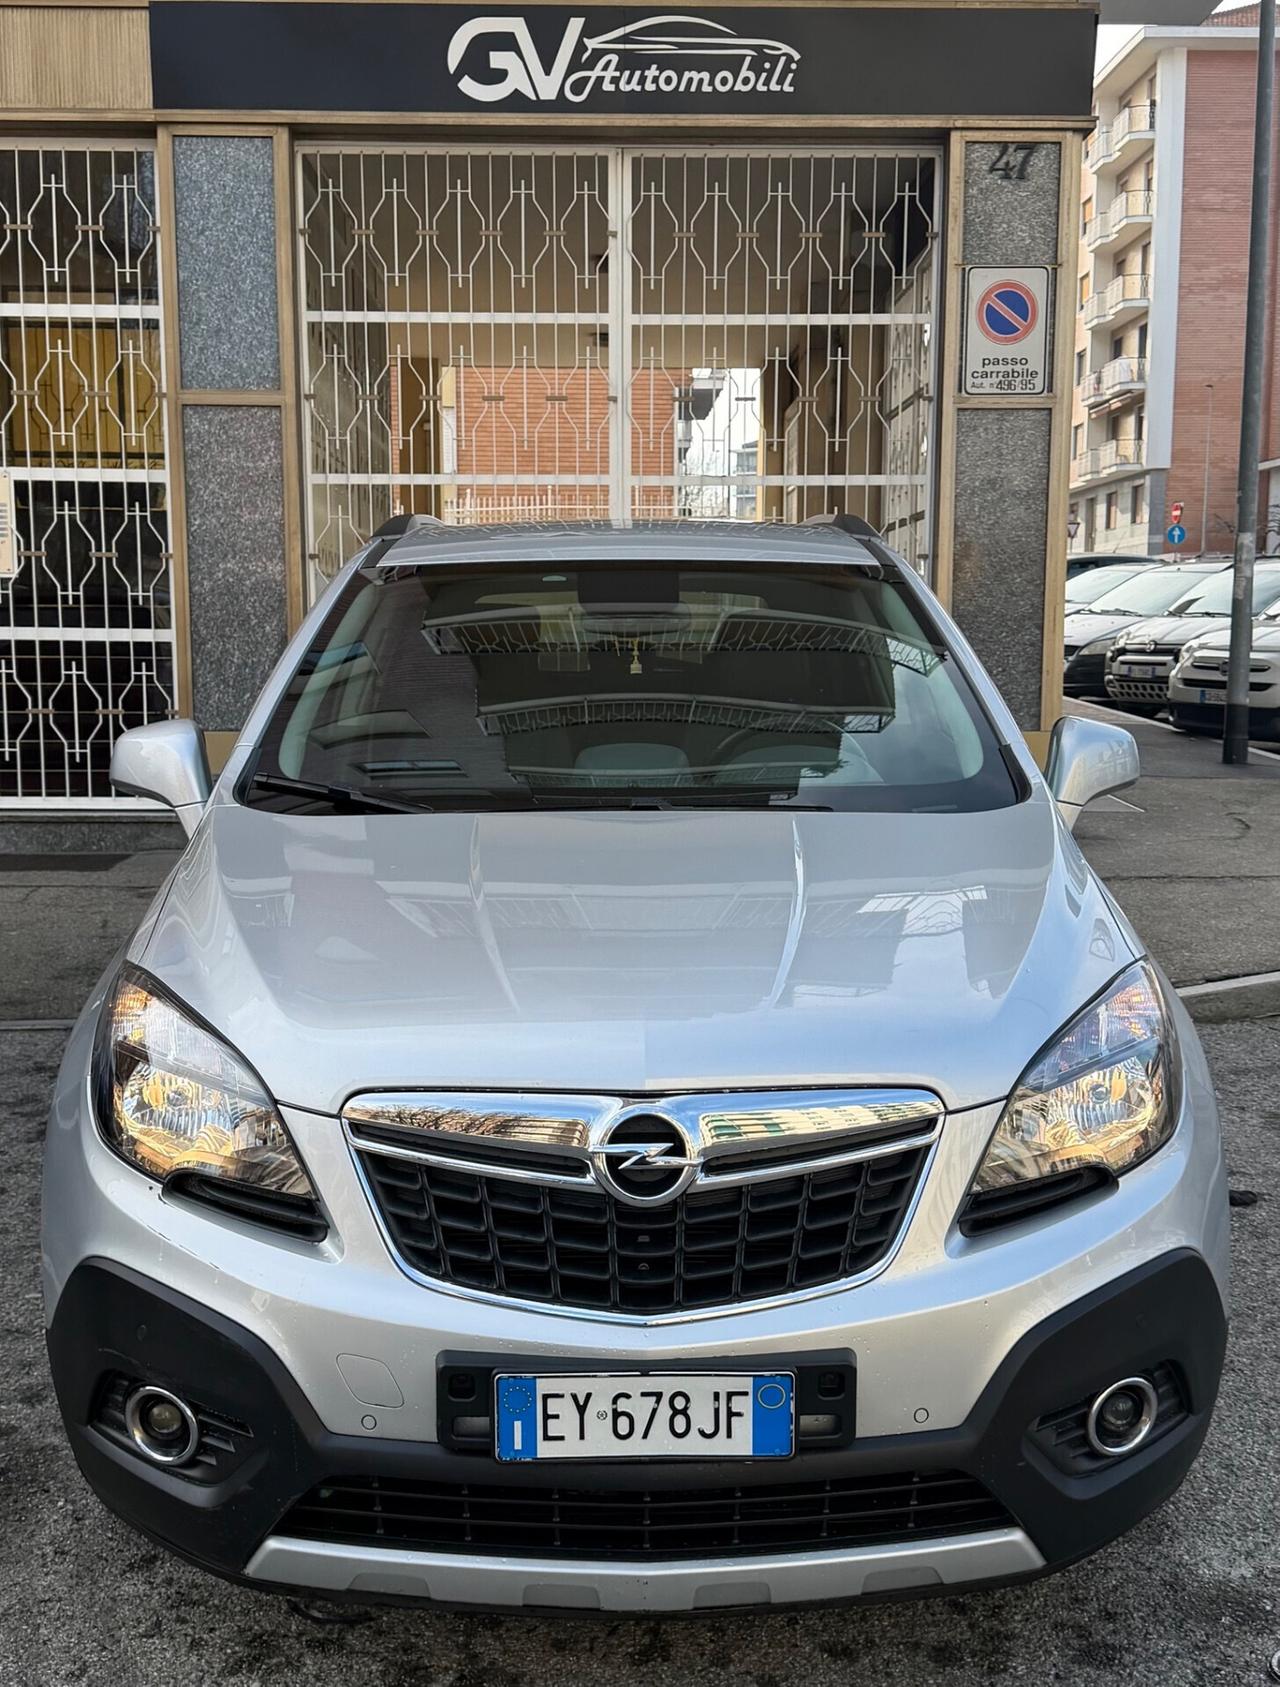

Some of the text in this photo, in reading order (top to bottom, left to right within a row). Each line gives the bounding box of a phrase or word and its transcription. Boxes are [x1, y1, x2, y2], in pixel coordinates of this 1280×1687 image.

[447, 17, 586, 102] GV
[564, 54, 798, 102] Automobili
[988, 144, 1038, 179] 47
[971, 368, 1039, 379] carrabile
[982, 357, 1029, 368] passo
